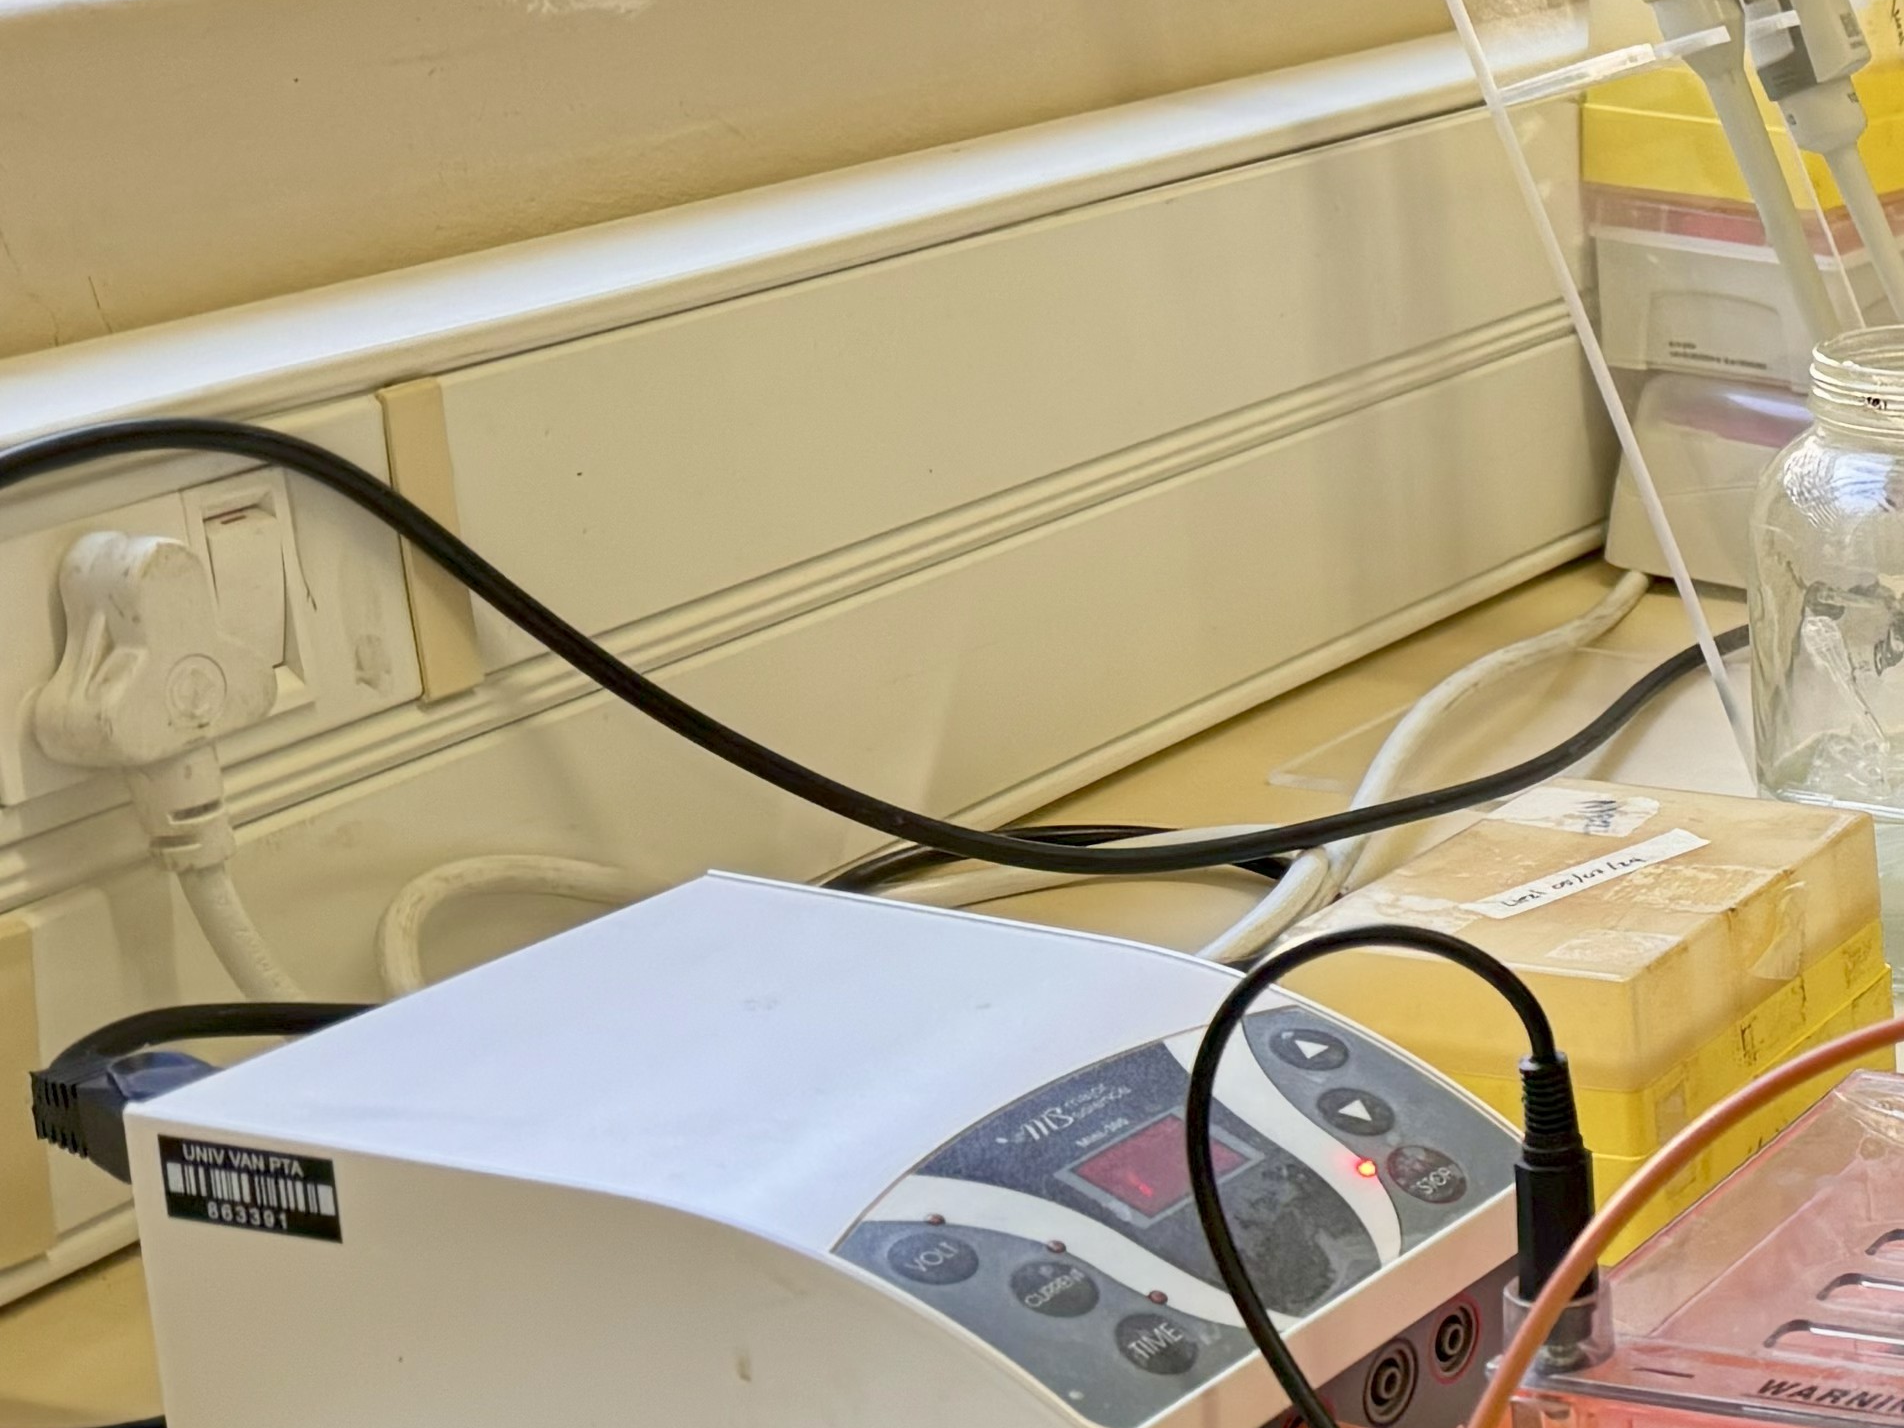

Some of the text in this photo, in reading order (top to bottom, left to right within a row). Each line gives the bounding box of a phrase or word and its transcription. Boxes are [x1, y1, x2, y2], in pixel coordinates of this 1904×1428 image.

[182, 1142, 305, 1178] UNIV VAN PTA
[904, 1240, 960, 1273] VOLT
[1127, 1321, 1185, 1360] TIME
